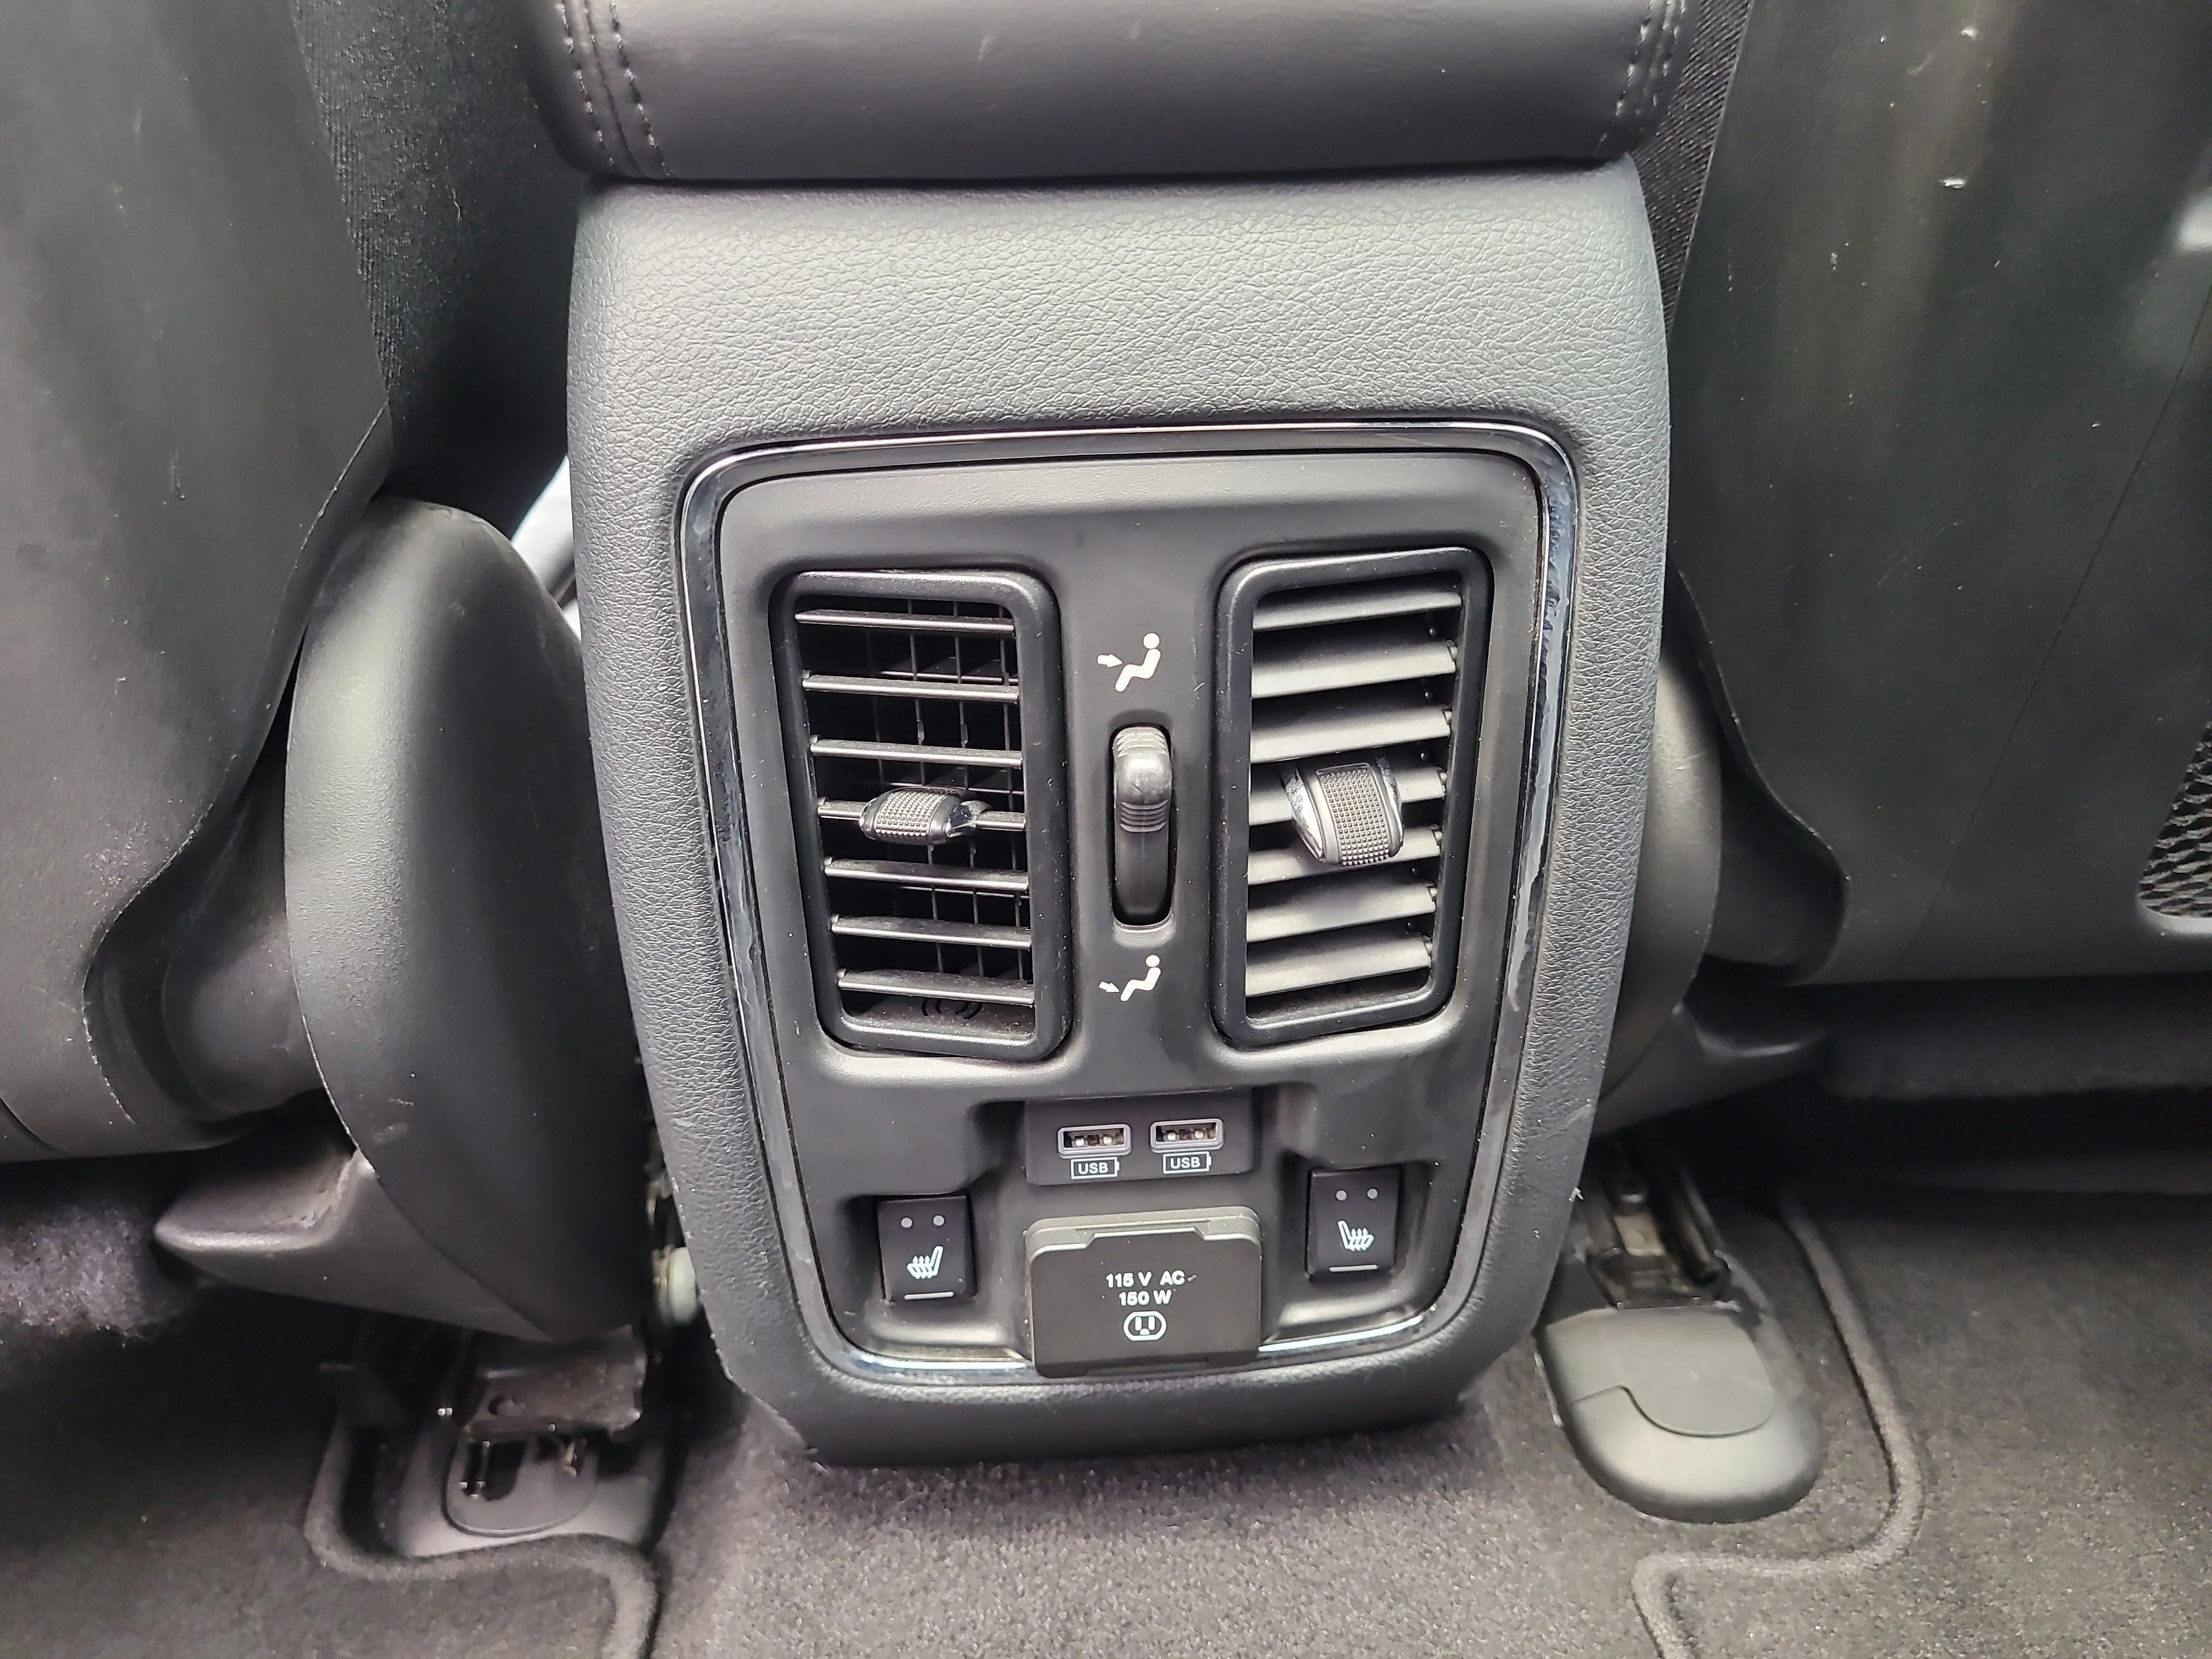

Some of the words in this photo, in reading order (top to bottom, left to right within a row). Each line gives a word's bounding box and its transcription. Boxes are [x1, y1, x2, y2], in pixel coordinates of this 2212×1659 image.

[1077, 1163, 1109, 1175] USB
[1170, 1156, 1201, 1169] USB
[1105, 1272, 1135, 1289] 115
[1137, 1271, 1152, 1287] V
[1159, 1270, 1186, 1286] AC
[1119, 1291, 1150, 1306] 150
[1153, 1289, 1172, 1305] W
